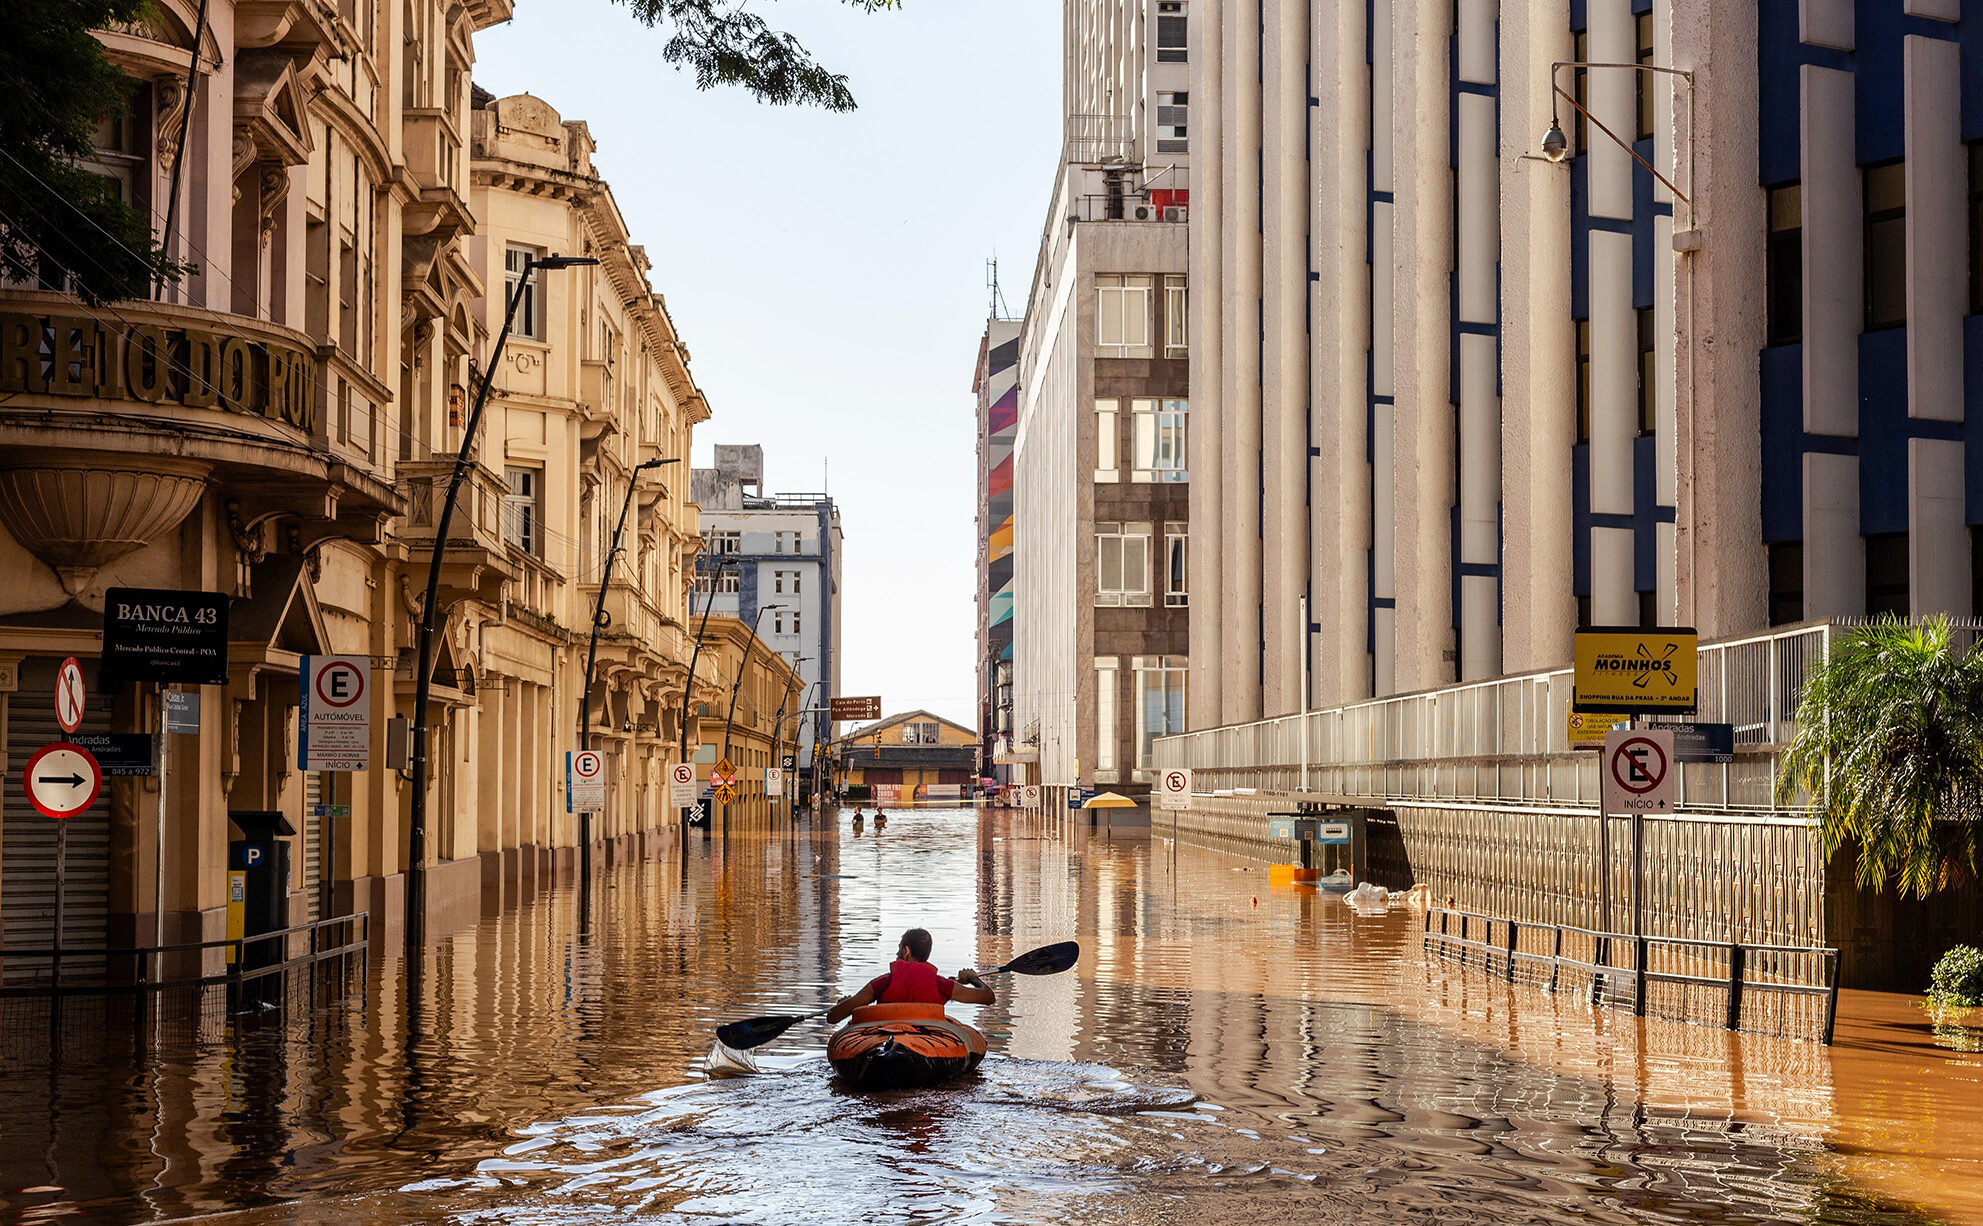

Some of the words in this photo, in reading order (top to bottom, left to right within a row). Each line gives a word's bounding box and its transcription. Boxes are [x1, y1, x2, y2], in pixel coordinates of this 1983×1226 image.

[183, 328, 251, 414] DO
[117, 603, 190, 623] BANCA
[194, 607, 216, 624] 43
[136, 624, 170, 634] Mercado
[172, 625, 201, 635] Público
[115, 644, 144, 652] Mercado
[144, 646, 169, 654] Público
[170, 647, 194, 655] Central
[1594, 660, 1671, 671] MOINHOS
[331, 671, 348, 697] E
[1651, 724, 1694, 732] Andradas
[583, 758, 592, 772] E
[1629, 750, 1648, 781] E
[680, 770, 686, 779] E
[1173, 776, 1180, 787] E
[1624, 799, 1653, 809] INÍCIO
[247, 848, 260, 864] P
